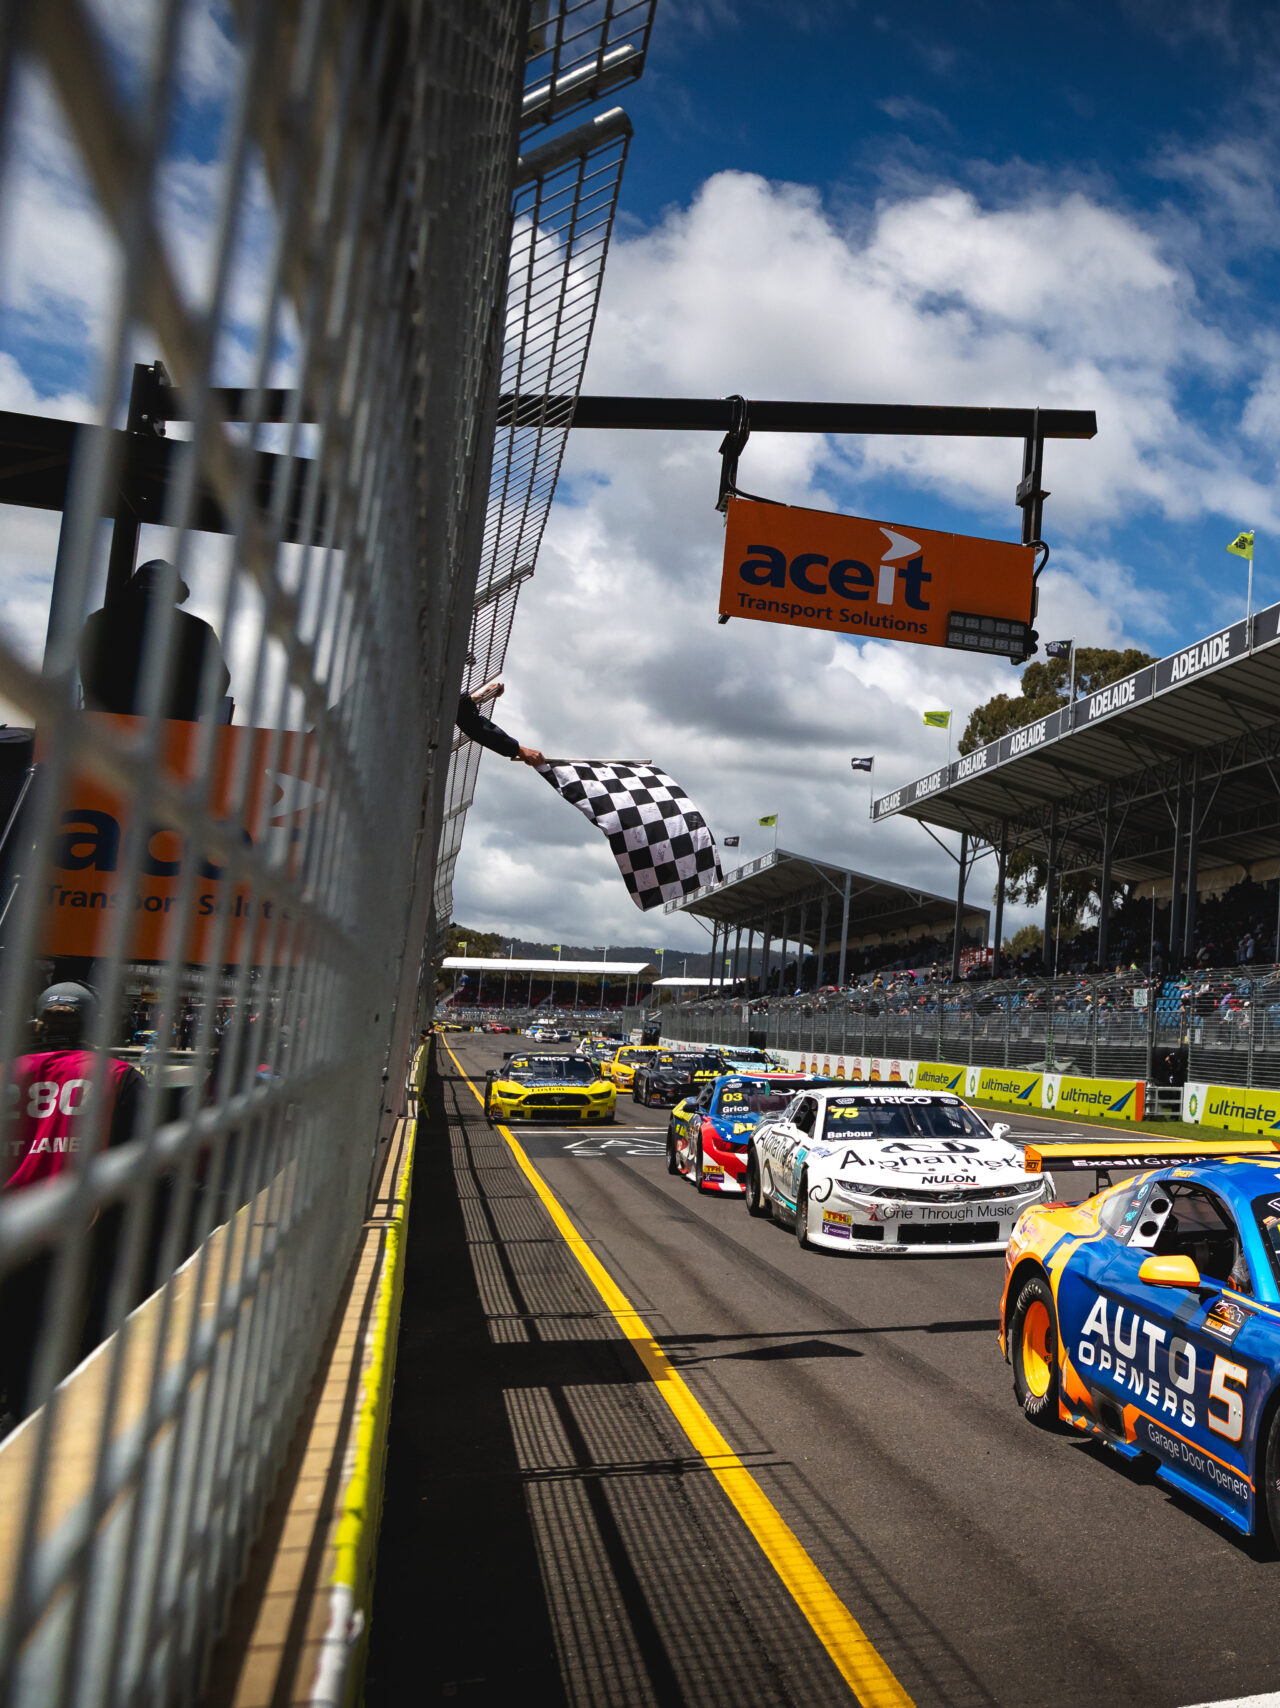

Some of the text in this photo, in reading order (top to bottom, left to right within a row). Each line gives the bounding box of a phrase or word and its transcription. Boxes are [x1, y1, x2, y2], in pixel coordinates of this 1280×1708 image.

[739, 527, 932, 611] aceit
[737, 592, 928, 635] Transport Solutions
[1171, 632, 1230, 682] ADELAIDE
[1088, 678, 1136, 719] ADELAIDE
[1010, 720, 1046, 756] ADELAIDE
[957, 749, 988, 780] ADELAIDE
[915, 771, 942, 799] ADELAIDE
[513, 1060, 529, 1068] 31
[918, 1070, 950, 1085] ultimate
[981, 1078, 1020, 1094] ultimate
[722, 1092, 743, 1102] 03
[864, 1096, 932, 1105] TRICO
[1061, 1087, 1112, 1106] ultimate
[722, 1105, 749, 1113] Grice
[831, 1107, 859, 1119] 75
[1208, 1100, 1277, 1122] ultimate
[827, 1131, 873, 1139] Barbour
[1072, 1158, 1141, 1167] Excell
[921, 1175, 977, 1184] NULON
[884, 1203, 1015, 1221] One Through Music
[1081, 1295, 1197, 1395] AUTO
[1078, 1340, 1197, 1428] OPENERS
[1208, 1354, 1248, 1442] 5
[1148, 1423, 1249, 1500] Garage Door Openers
